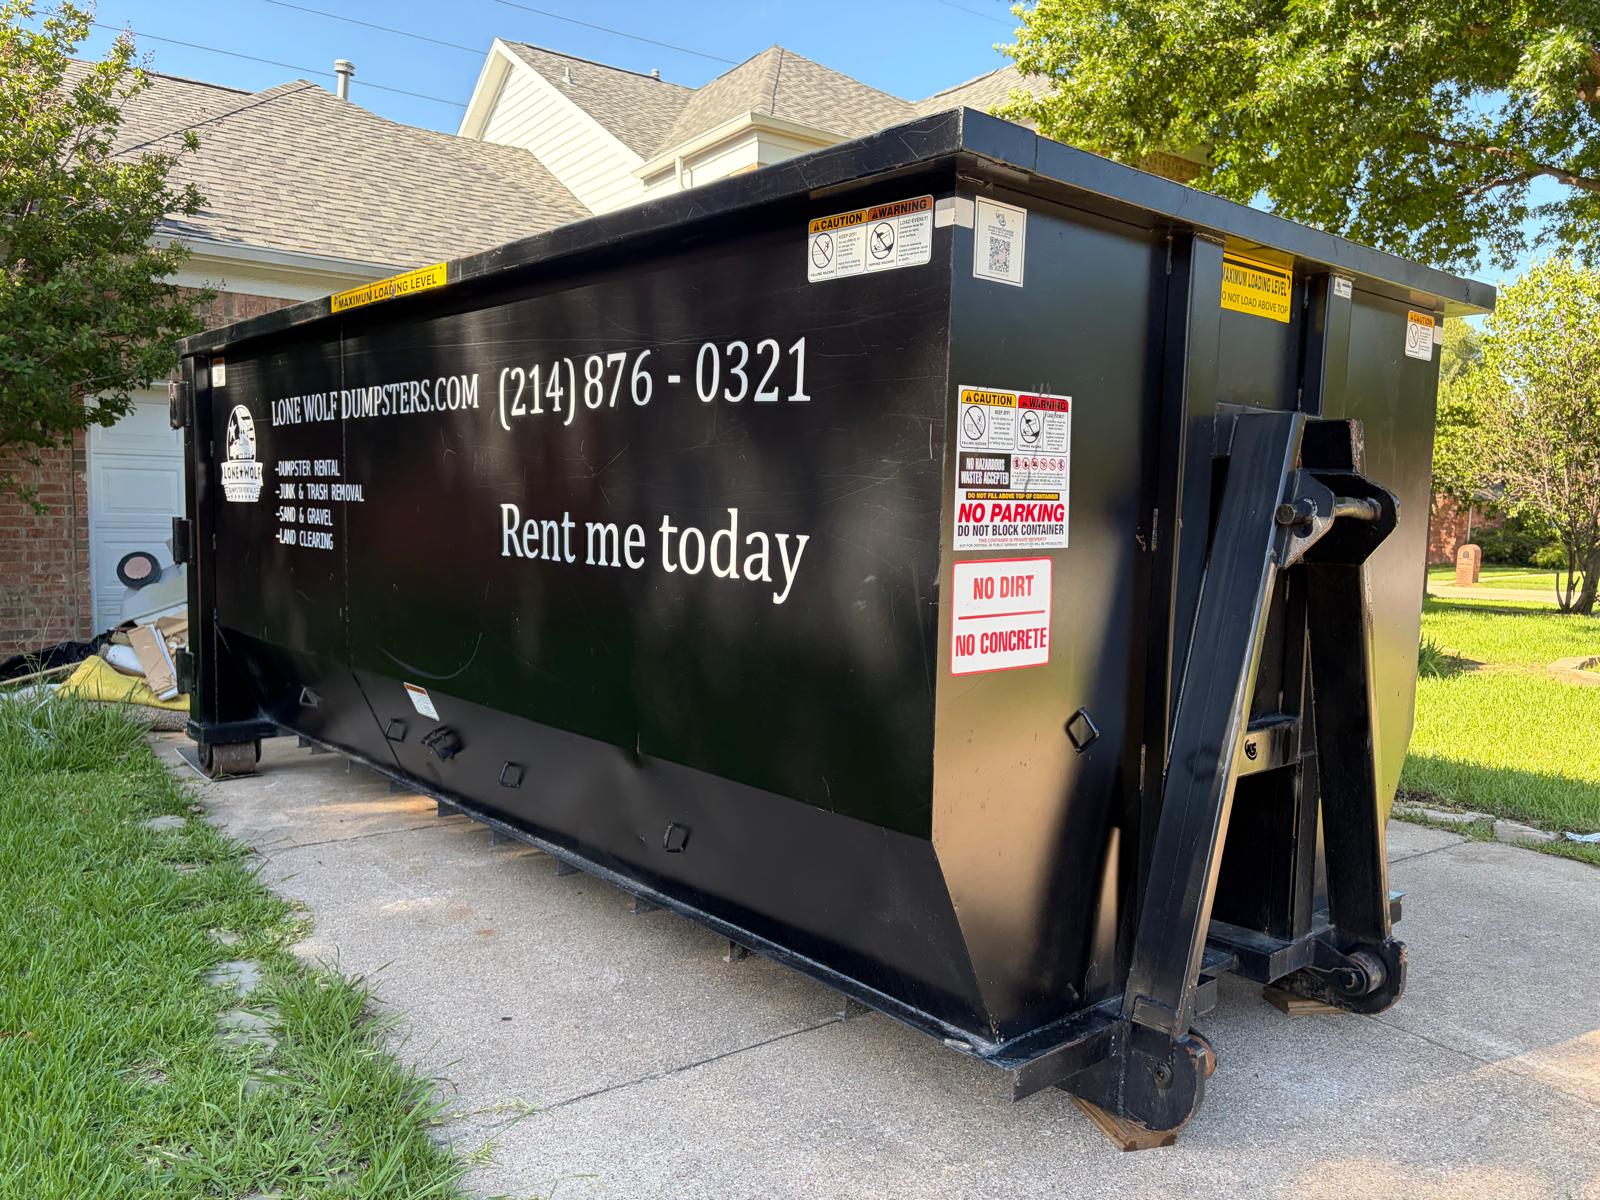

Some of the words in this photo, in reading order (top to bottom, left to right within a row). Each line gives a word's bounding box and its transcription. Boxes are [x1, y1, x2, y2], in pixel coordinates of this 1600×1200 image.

[878, 199, 927, 218] WARNING
[821, 213, 862, 229] CAUTION
[338, 292, 372, 309] MAXIMUM
[374, 281, 408, 299] LOADING
[411, 274, 436, 289] LEVEL
[1248, 272, 1271, 293] LOADING
[1272, 279, 1287, 296] LEVEL
[1222, 291, 1226, 301] O
[1228, 292, 1240, 303] NOT
[1241, 296, 1257, 307] LOAD
[1258, 299, 1276, 312] ABOVE
[1277, 304, 1288, 314] TOP
[1413, 314, 1433, 326] CAUTION
[695, 336, 811, 403] 0321
[271, 397, 300, 427] LONE
[302, 391, 338, 422] WOLF
[340, 373, 479, 419] DUMPSTERS.COM
[973, 393, 1012, 405] CAUTION
[1030, 398, 1066, 411] WARNING
[224, 466, 239, 480] LONE
[244, 466, 260, 480] WOLF
[314, 459, 340, 476] RENTAL
[966, 458, 974, 470] NO
[975, 458, 1005, 471] HAZARDOUS
[960, 471, 982, 484] WASTES
[983, 472, 1009, 484] ACCEPTED
[298, 483, 304, 499] &
[306, 483, 328, 500] TRASH
[331, 484, 364, 502] REMOVAL
[299, 507, 304, 523] &
[307, 507, 333, 526] GRAVEL
[958, 503, 985, 523] NO
[990, 503, 1065, 523] PARKING
[958, 525, 969, 536] DO
[973, 525, 989, 536] NOT
[992, 524, 1018, 536] BLOCK
[1022, 524, 1064, 536] CONTAINER
[299, 530, 333, 550] CLEARING
[500, 503, 576, 564] Rent
[585, 520, 646, 570] me
[659, 508, 810, 604] today
[973, 576, 994, 600] NO
[1000, 575, 1034, 598] DIRT
[956, 634, 975, 657] NO
[980, 627, 1047, 655] CONCRETE
